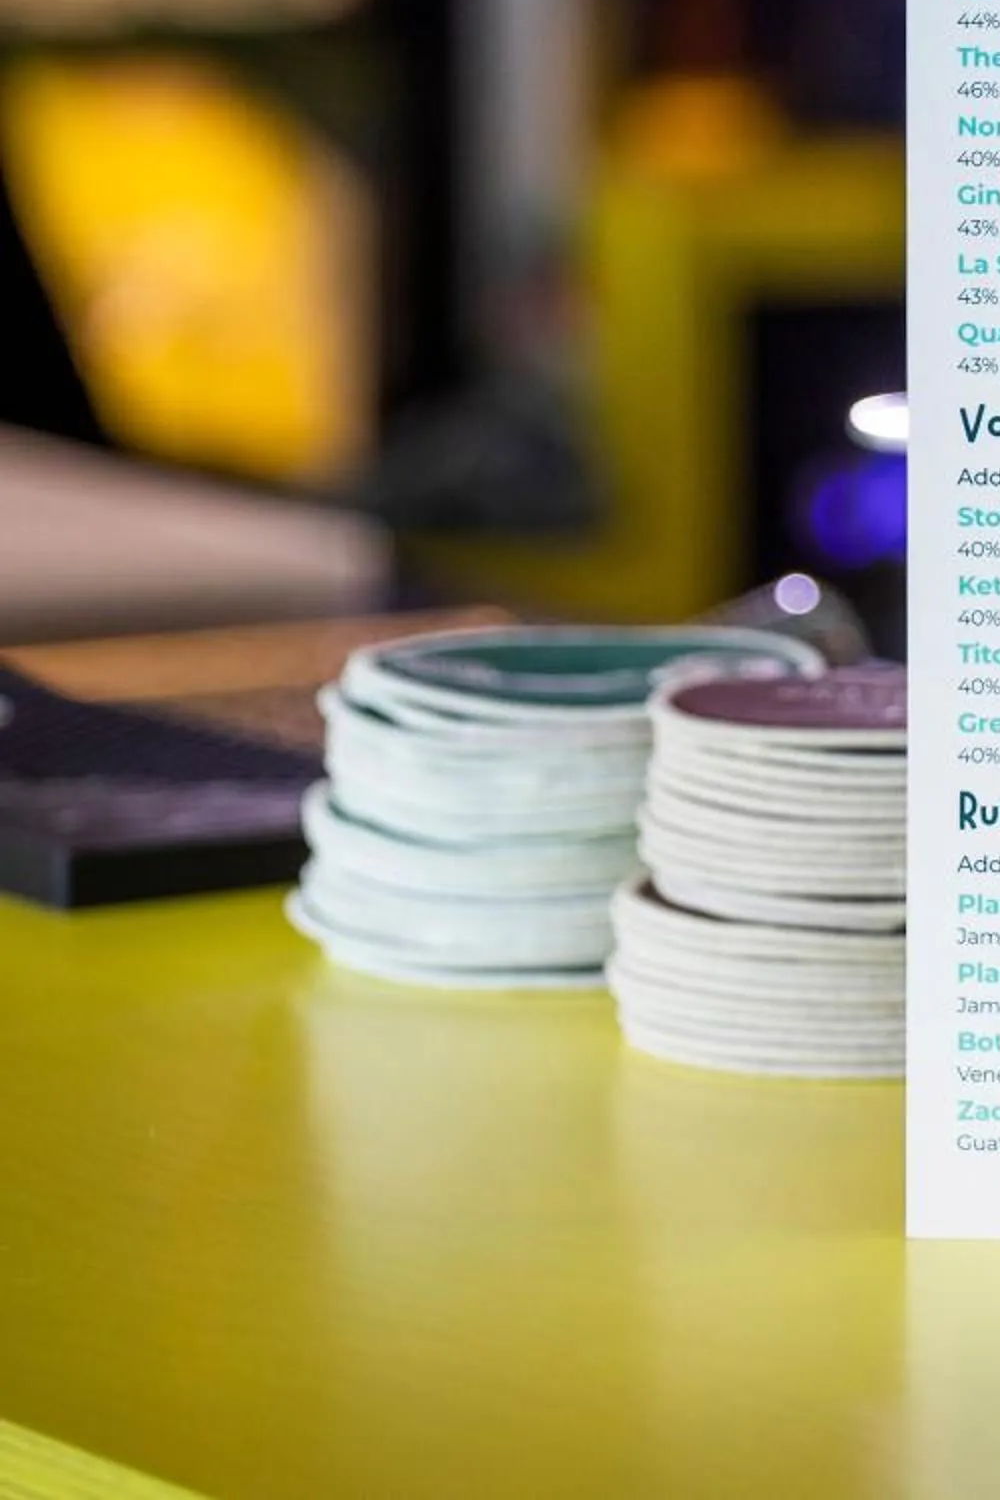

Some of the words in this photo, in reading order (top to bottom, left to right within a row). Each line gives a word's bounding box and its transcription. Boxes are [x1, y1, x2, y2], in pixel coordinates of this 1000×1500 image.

[956, 11, 1000, 31] 44%
[956, 219, 1000, 238] 43%
[957, 251, 991, 277] La
[956, 286, 999, 306] 43%
[956, 356, 1000, 375] 43%
